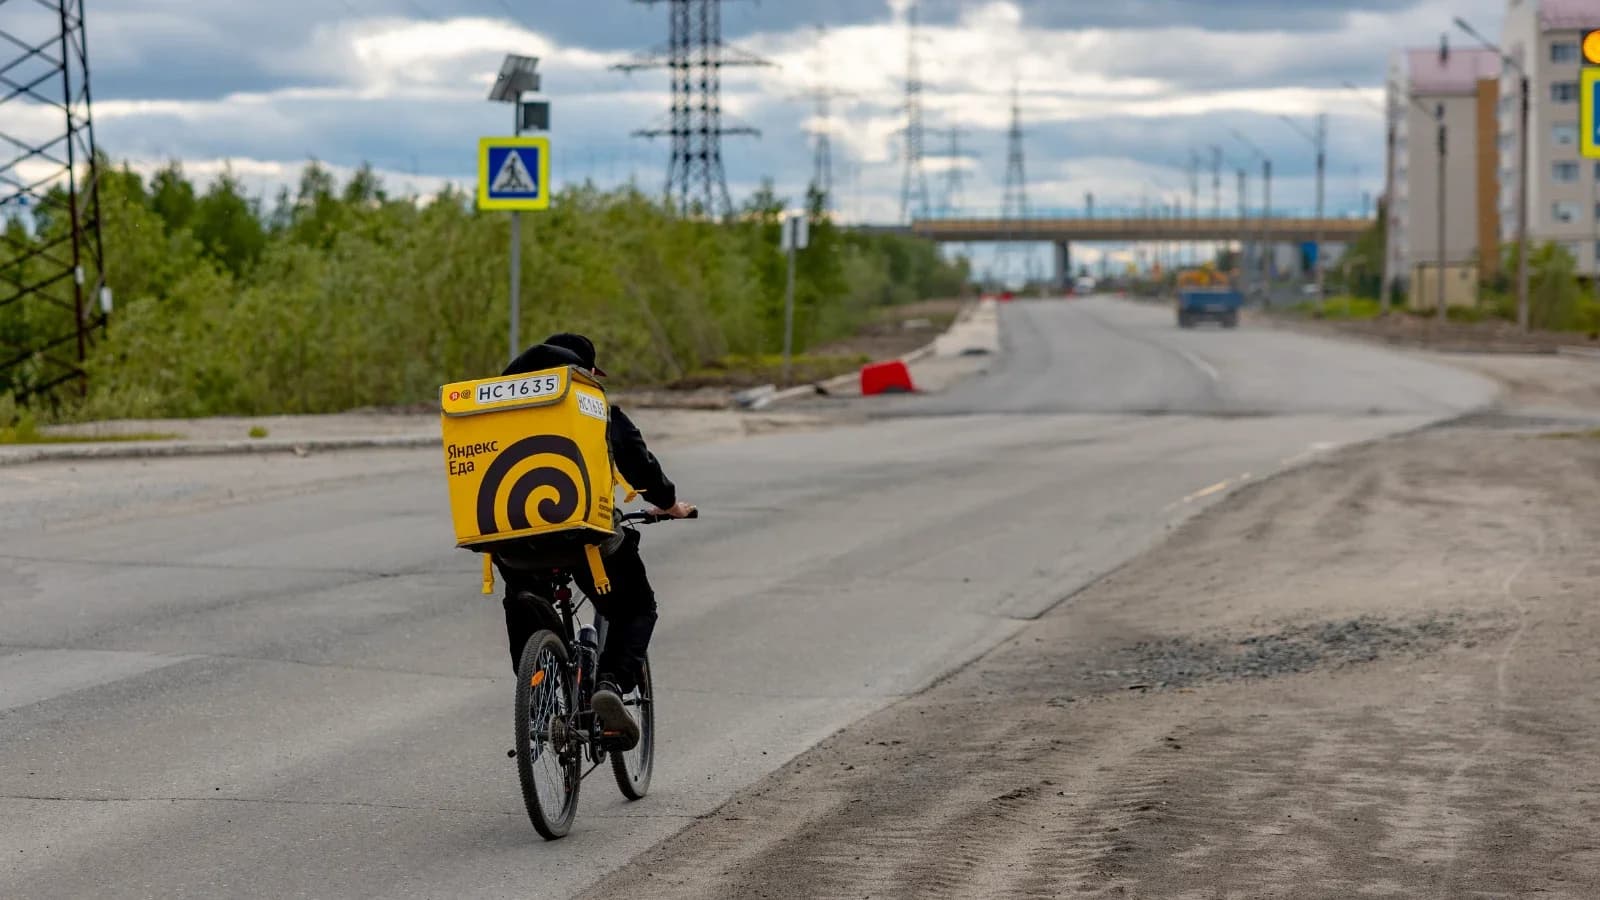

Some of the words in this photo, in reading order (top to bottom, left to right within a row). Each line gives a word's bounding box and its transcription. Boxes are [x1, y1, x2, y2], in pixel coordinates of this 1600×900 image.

[479, 378, 555, 400] НС1635
[448, 440, 498, 459] Яндекс
[449, 460, 475, 476] Еда
